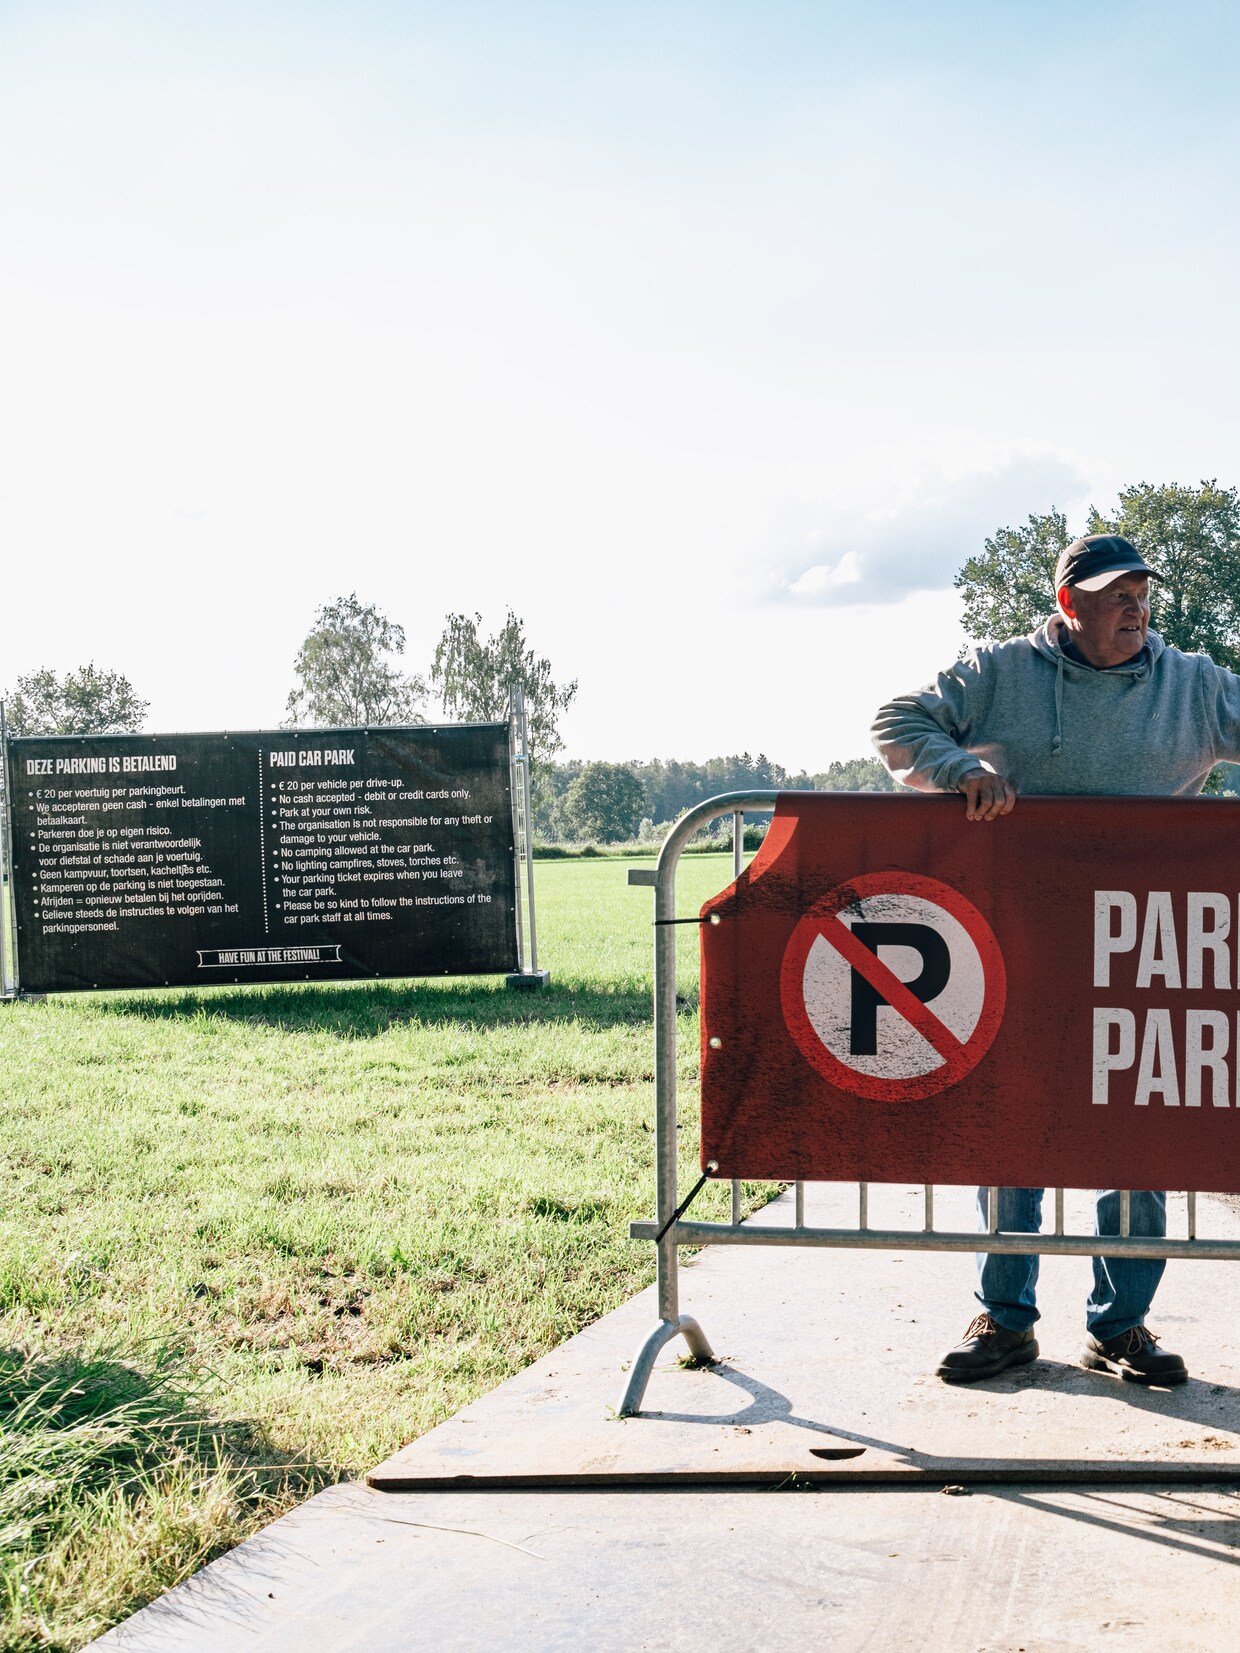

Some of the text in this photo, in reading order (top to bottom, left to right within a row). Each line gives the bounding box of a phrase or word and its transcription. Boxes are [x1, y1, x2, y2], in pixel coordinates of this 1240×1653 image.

[26, 754, 176, 774] DEZE PARKING IS BETALEND
[269, 749, 354, 766] PAID CAR PARK
[36, 784, 185, 799] € 20 per voertuig per parkingbeurt.
[278, 777, 404, 791] € 20 per vehicle per drive-up.
[279, 794, 290, 803] No
[293, 793, 313, 803] cash
[315, 792, 354, 803] accepted
[364, 791, 385, 800] debit
[398, 789, 423, 799] credit
[425, 789, 449, 799] cards
[450, 788, 470, 799] only.
[36, 802, 49, 812] We
[52, 801, 99, 812] accepteren
[102, 801, 123, 812] geen
[126, 799, 146, 809] cash
[156, 798, 178, 808] enkel
[181, 797, 225, 808] betalingen
[228, 796, 244, 805] met
[279, 805, 372, 818] Park at your own risk.
[36, 814, 87, 825] betaalkaart.
[278, 820, 295, 830] The
[297, 819, 350, 831] organisation
[352, 818, 360, 828] is
[362, 818, 376, 827] not
[378, 816, 427, 828] responsible
[429, 815, 442, 825] for
[443, 817, 459, 826] any
[461, 814, 482, 824] theft
[37, 825, 171, 839] Parkeren doe je op eigen risico.
[280, 831, 381, 844] damage to your vehicle.
[38, 837, 201, 853] De organisatie is niet verantwoordelijk
[281, 842, 434, 857] No camping allowed at the car park.
[59, 854, 91, 865] diefstal
[92, 854, 102, 864] of
[103, 853, 135, 863] schade
[137, 854, 153, 862] aan
[155, 852, 163, 863] je
[165, 850, 203, 862] voertuig.
[281, 855, 459, 871] No lighting campfires, stoves, torches etc.
[39, 864, 212, 879] Geen kampvuur, toortsen, kacheltjes etc.
[281, 868, 463, 884] Your parking ticket expires when you leave
[40, 877, 224, 893] Kamperen op de parking is niet toegestaan.
[282, 886, 336, 897] the car park.
[40, 896, 73, 907] Afrijden
[85, 894, 122, 906] opnieuw
[124, 893, 156, 903] betalen
[158, 892, 169, 903] bij
[171, 891, 185, 901] het
[186, 890, 223, 902] oprijden.
[283, 900, 311, 910] Please
[313, 900, 325, 909] be
[339, 898, 358, 908] kind
[360, 898, 369, 907] to
[370, 897, 397, 906] follow
[398, 896, 413, 906] the
[414, 894, 465, 905] instructions
[466, 893, 475, 903] of
[477, 893, 491, 902] the
[41, 909, 73, 919] Gelieve
[75, 908, 104, 918] steeds
[105, 907, 117, 917] de
[119, 906, 164, 916] instructies
[165, 906, 175, 914] te
[176, 904, 204, 916] volgen
[224, 903, 238, 912] het
[283, 911, 392, 924] car park staff at all times.
[42, 920, 119, 934] parkingpersoneel.
[218, 949, 320, 963] HAVE FUN AT THE FESTIVAL!
